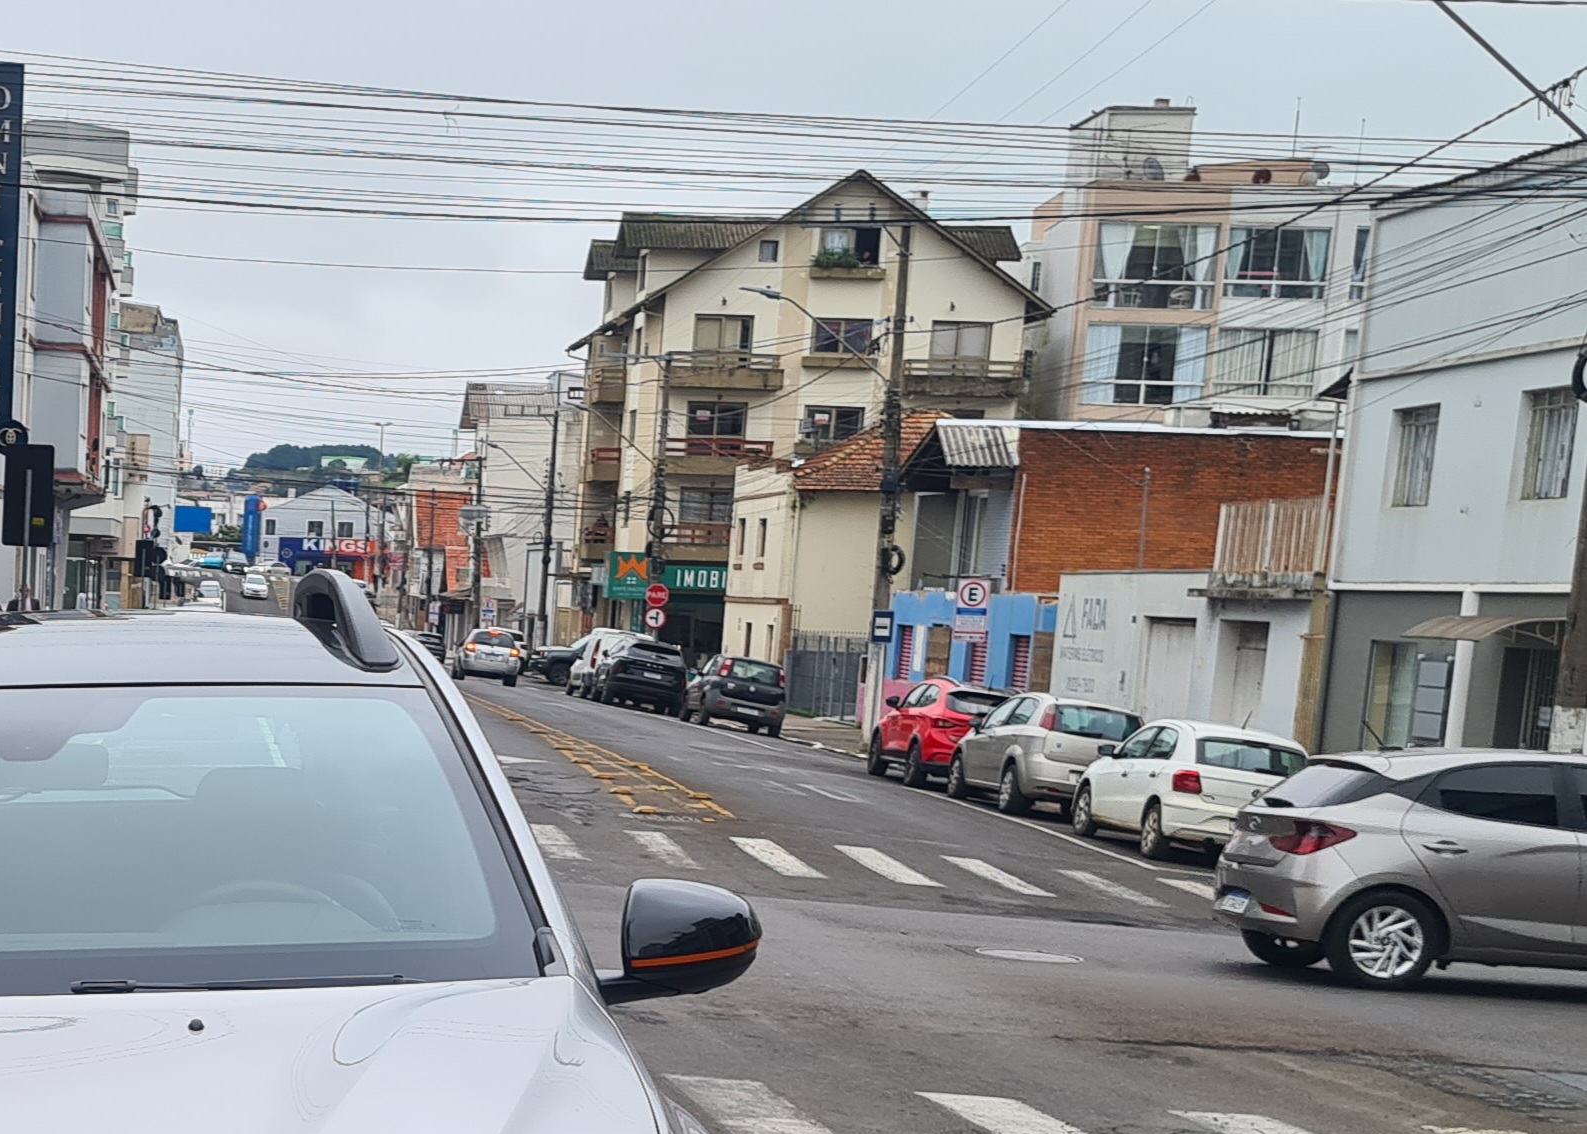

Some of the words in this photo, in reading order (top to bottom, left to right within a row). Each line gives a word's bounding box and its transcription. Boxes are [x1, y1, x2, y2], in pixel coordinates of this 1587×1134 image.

[302, 538, 371, 553] KINGS
[647, 591, 668, 599] PARE
[968, 587, 979, 602] E
